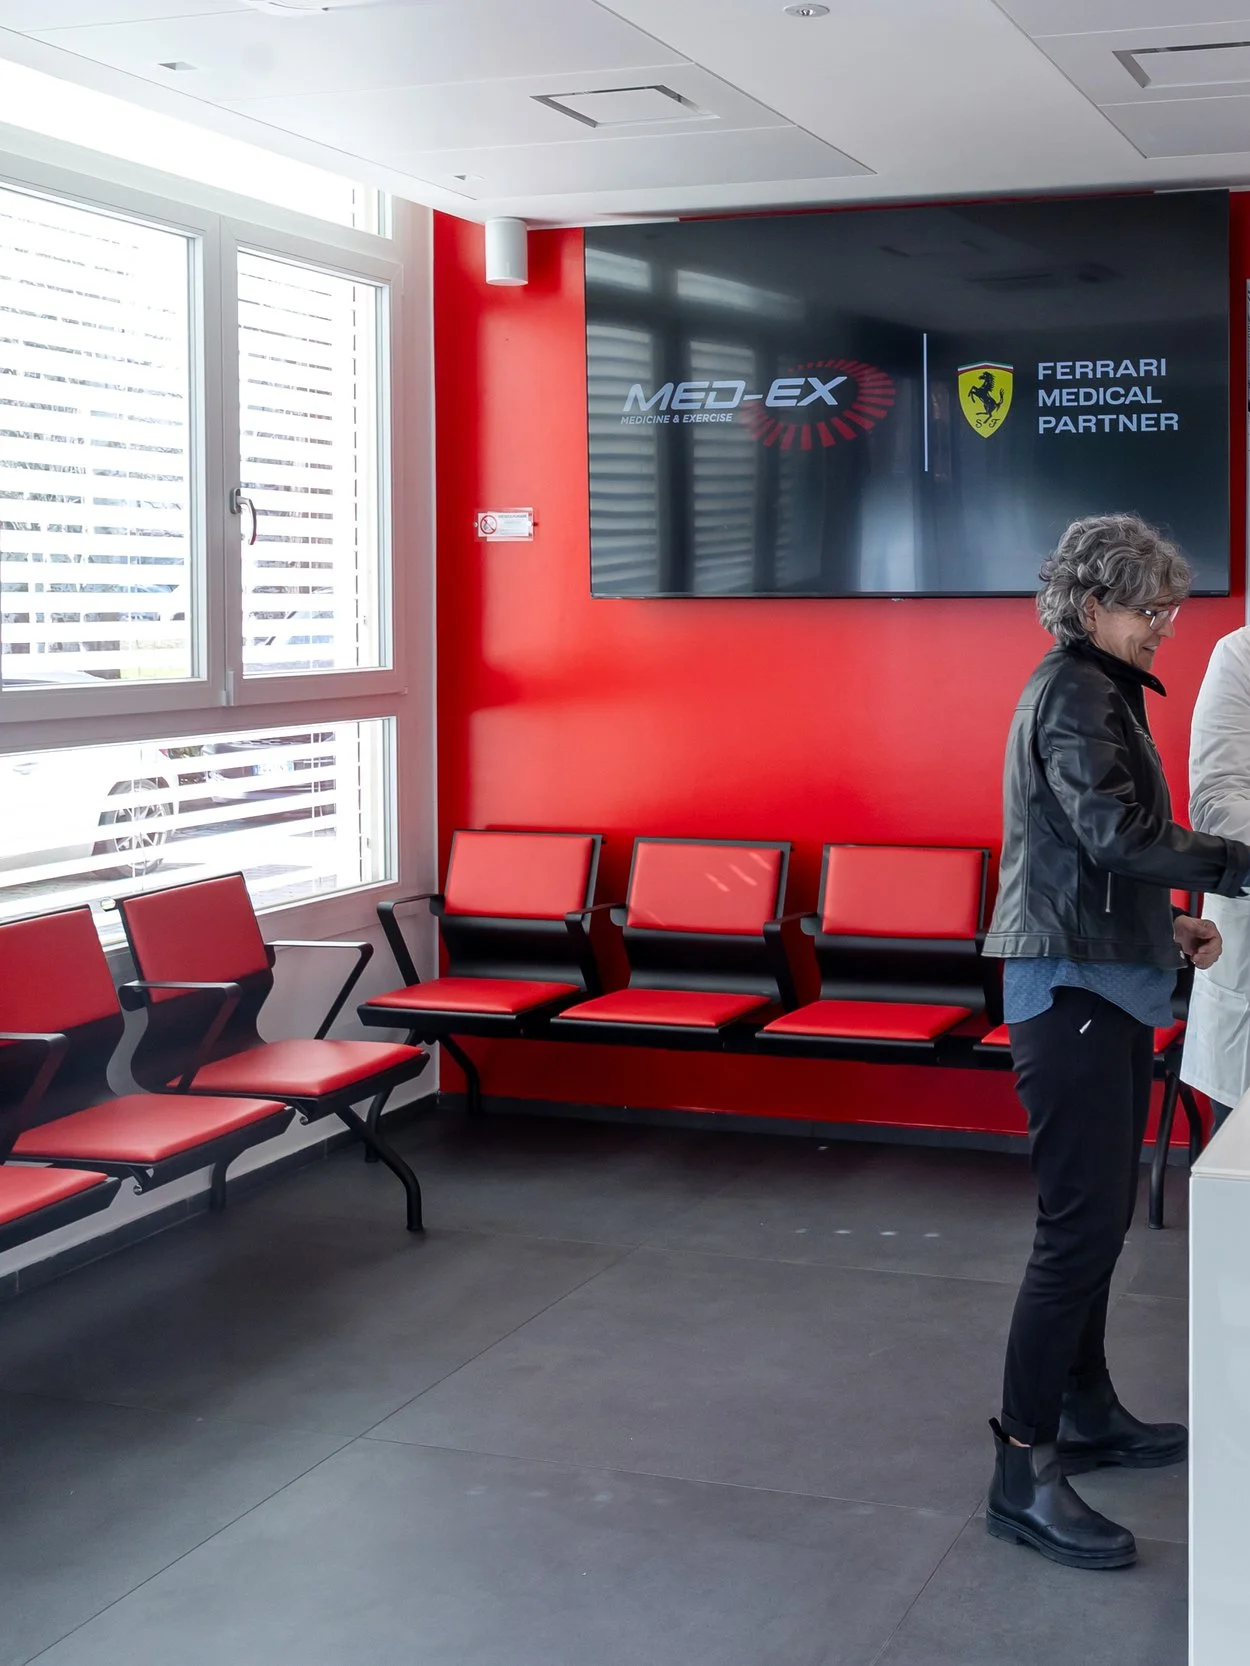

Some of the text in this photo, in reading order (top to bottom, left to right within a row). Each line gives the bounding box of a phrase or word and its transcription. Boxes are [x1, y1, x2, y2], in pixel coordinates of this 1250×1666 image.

[1038, 359, 1166, 380] FERRARI
[623, 376, 848, 412] MED-EX
[1038, 386, 1162, 407] MEDICAL
[620, 413, 734, 425] MEDICINE & EXERCISE
[1038, 413, 1179, 434] PARTNER
